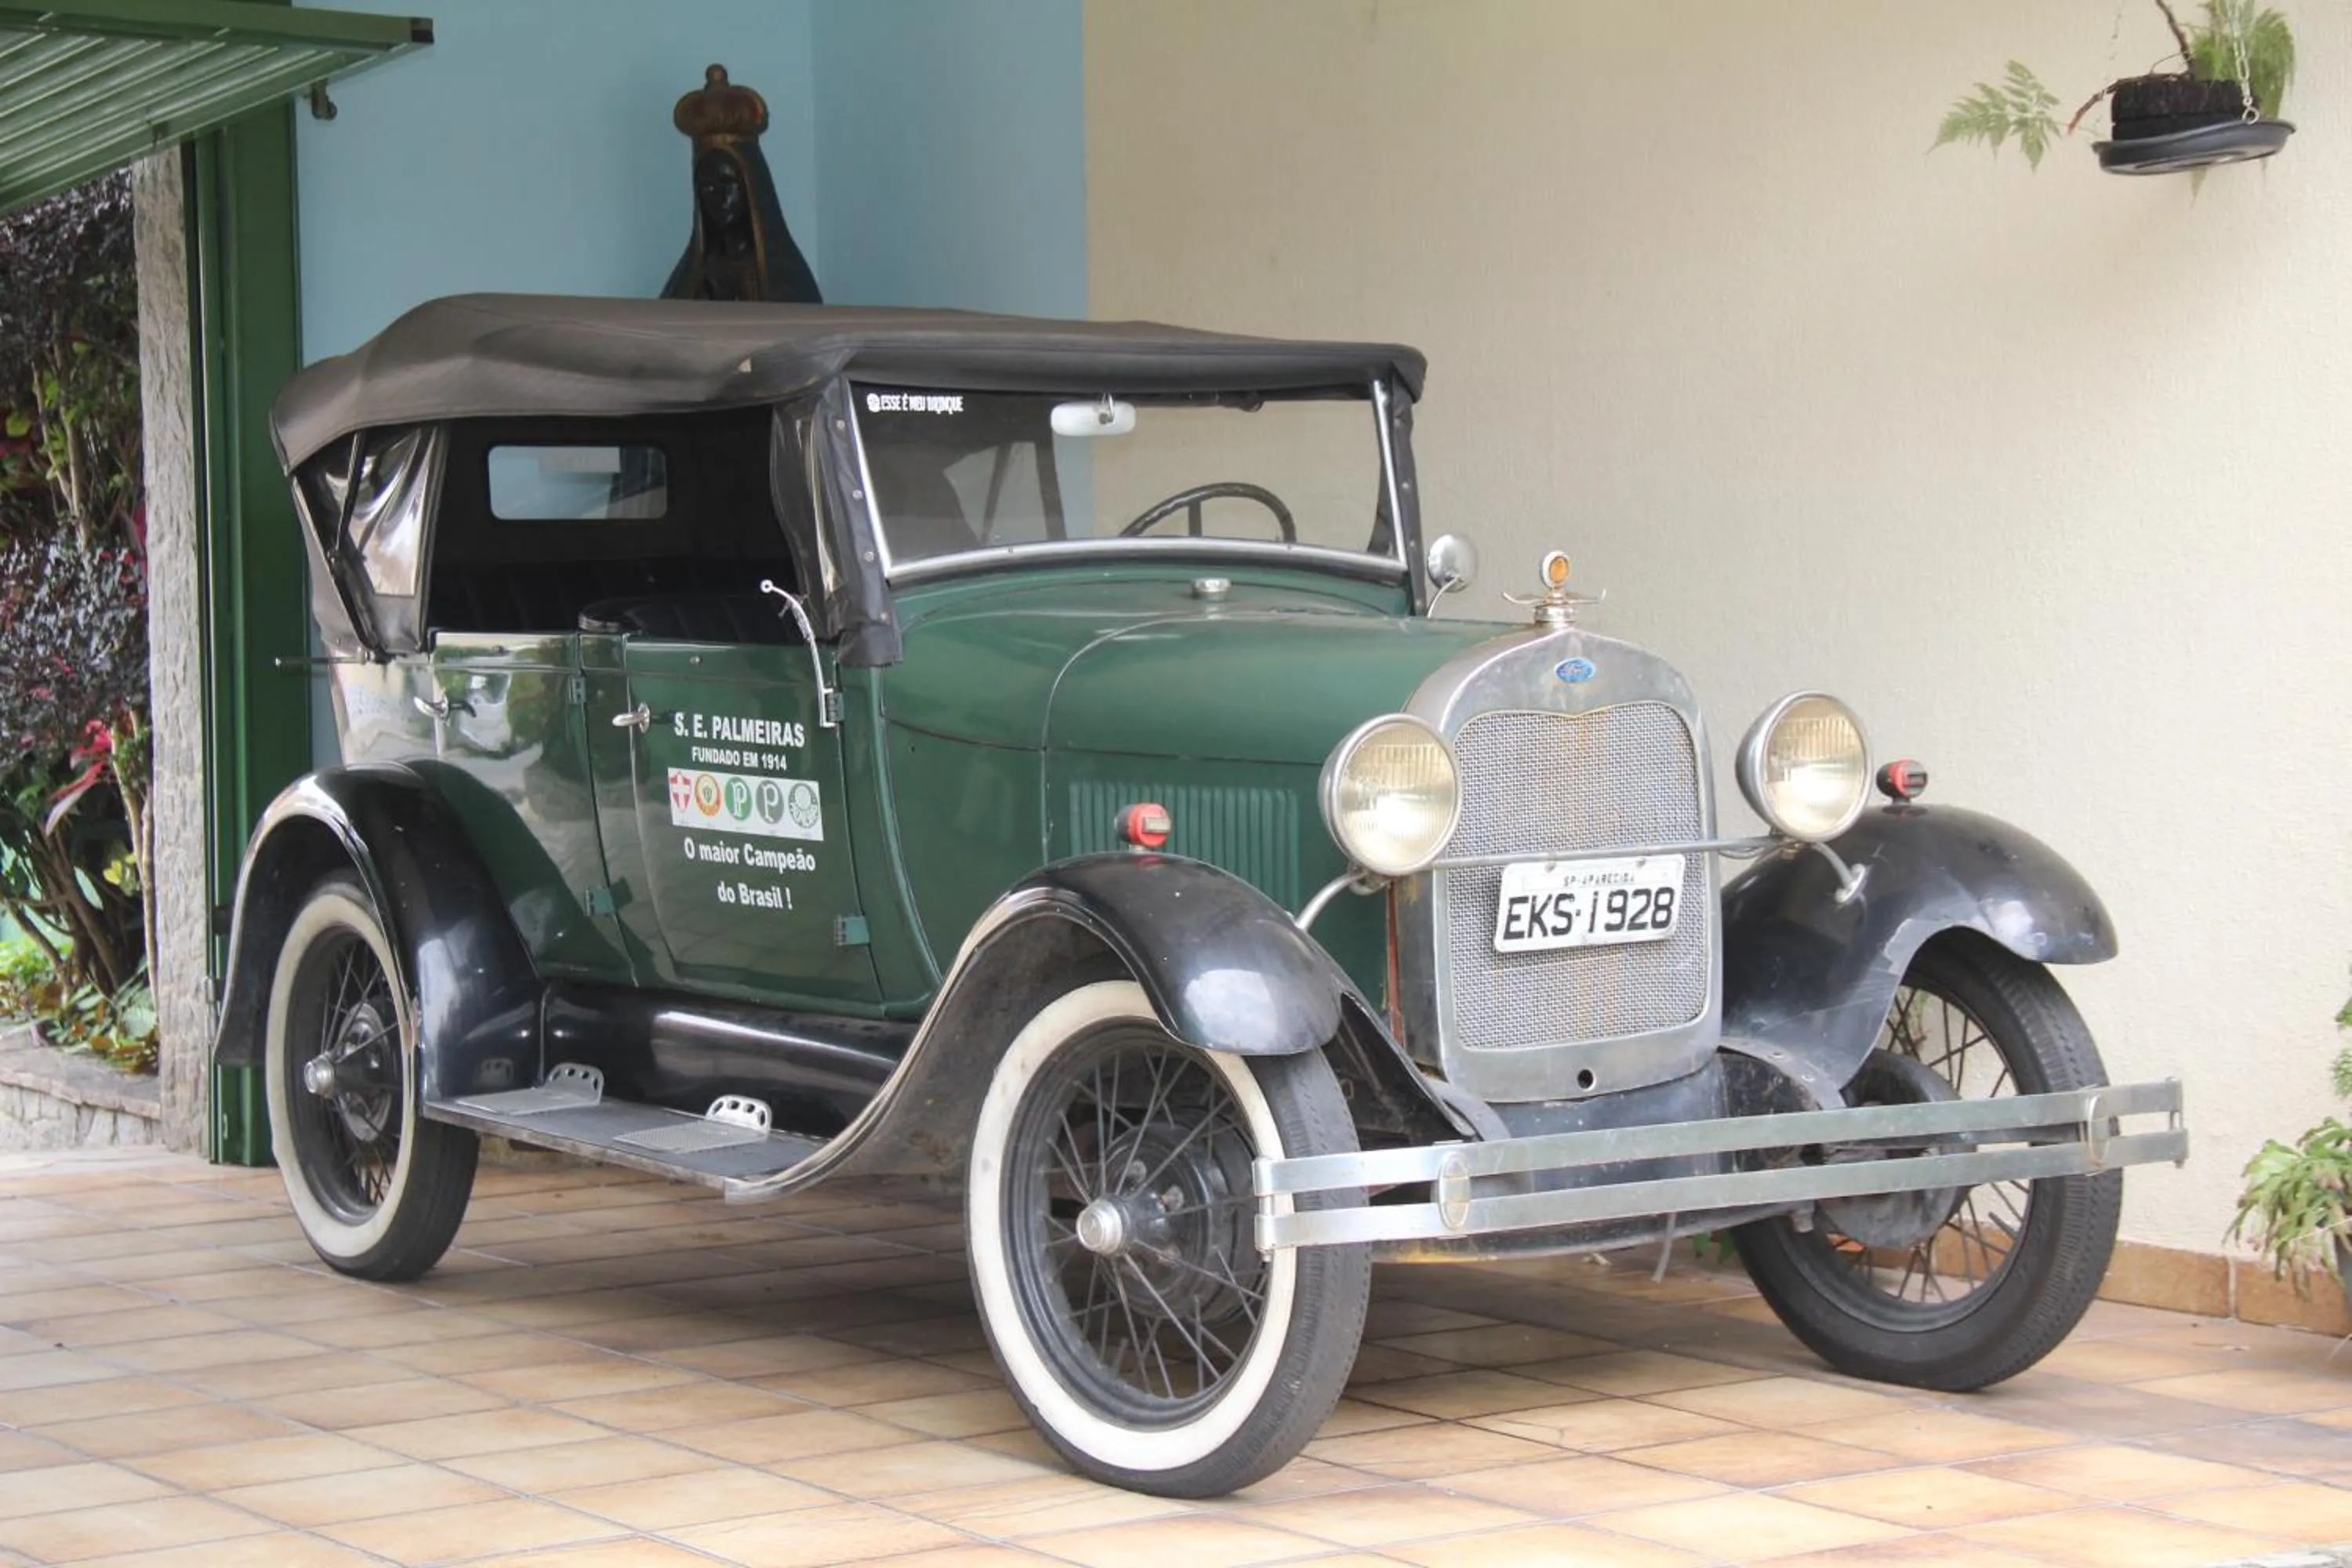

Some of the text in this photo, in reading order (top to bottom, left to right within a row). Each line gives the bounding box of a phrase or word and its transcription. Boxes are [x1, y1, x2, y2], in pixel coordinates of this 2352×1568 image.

[880, 394, 901, 411] ESSE
[902, 393, 908, 411] É
[674, 712, 805, 748] S. E. PALMEIRAS
[691, 746, 787, 771] FUNDADO EM 1914
[684, 837, 816, 874] O maior Campeão
[717, 881, 735, 904] do
[739, 883, 782, 909] Brasil
